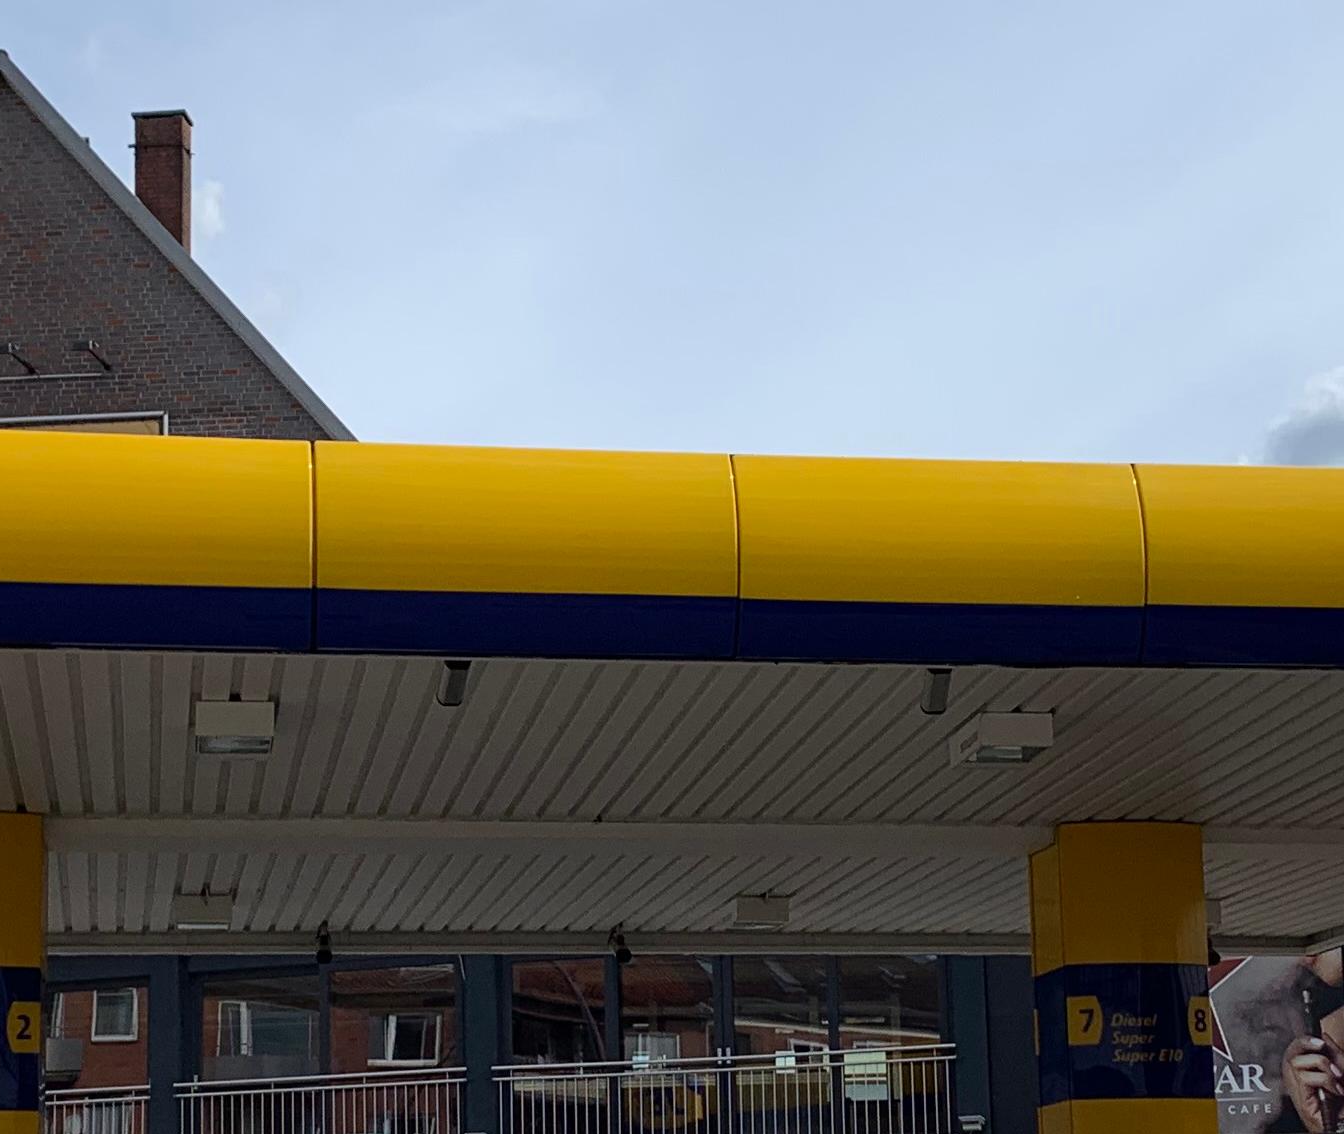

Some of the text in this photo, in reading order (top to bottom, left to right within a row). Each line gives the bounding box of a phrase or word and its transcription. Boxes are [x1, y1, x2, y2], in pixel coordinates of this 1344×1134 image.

[16, 1014, 32, 1040] 2
[1078, 1009, 1094, 1033] 7
[1110, 1013, 1157, 1028] Diesel
[1194, 1009, 1207, 1033] 8
[1111, 1031, 1155, 1047] Super
[1112, 1049, 1184, 1065] Super E10
[1213, 1064, 1272, 1094] AR
[1227, 1104, 1272, 1115] CAFE
